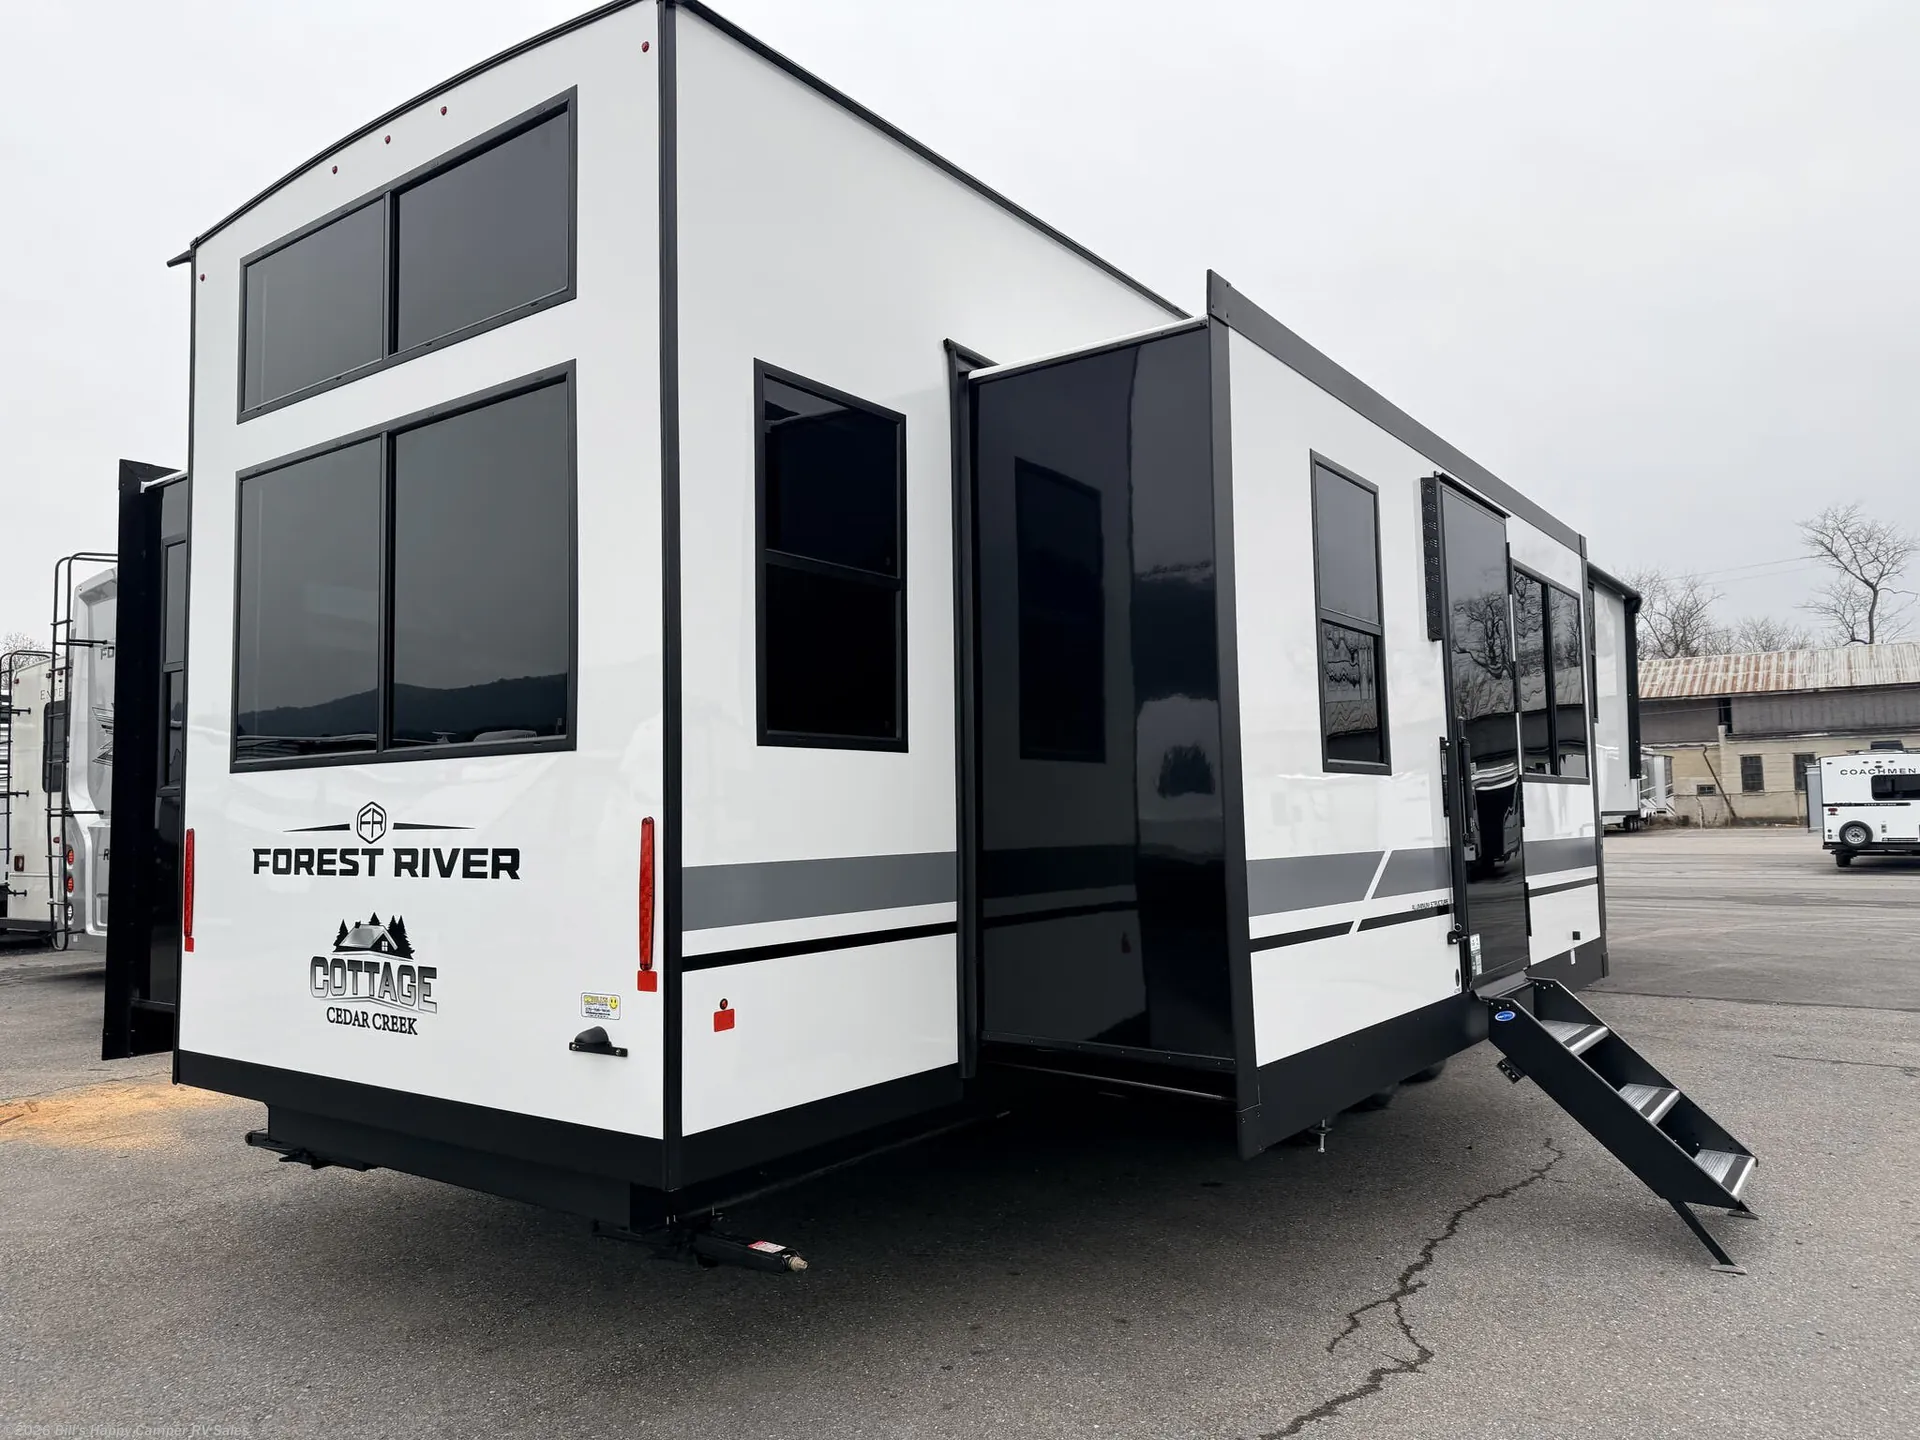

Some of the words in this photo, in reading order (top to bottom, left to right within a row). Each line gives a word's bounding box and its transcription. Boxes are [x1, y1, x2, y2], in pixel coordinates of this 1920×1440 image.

[252, 847, 385, 877] FOREST
[392, 847, 521, 880] RIVER
[309, 955, 438, 1014] COTTAGE
[326, 1006, 371, 1028] CEDAR
[372, 1012, 418, 1036] CREEK
